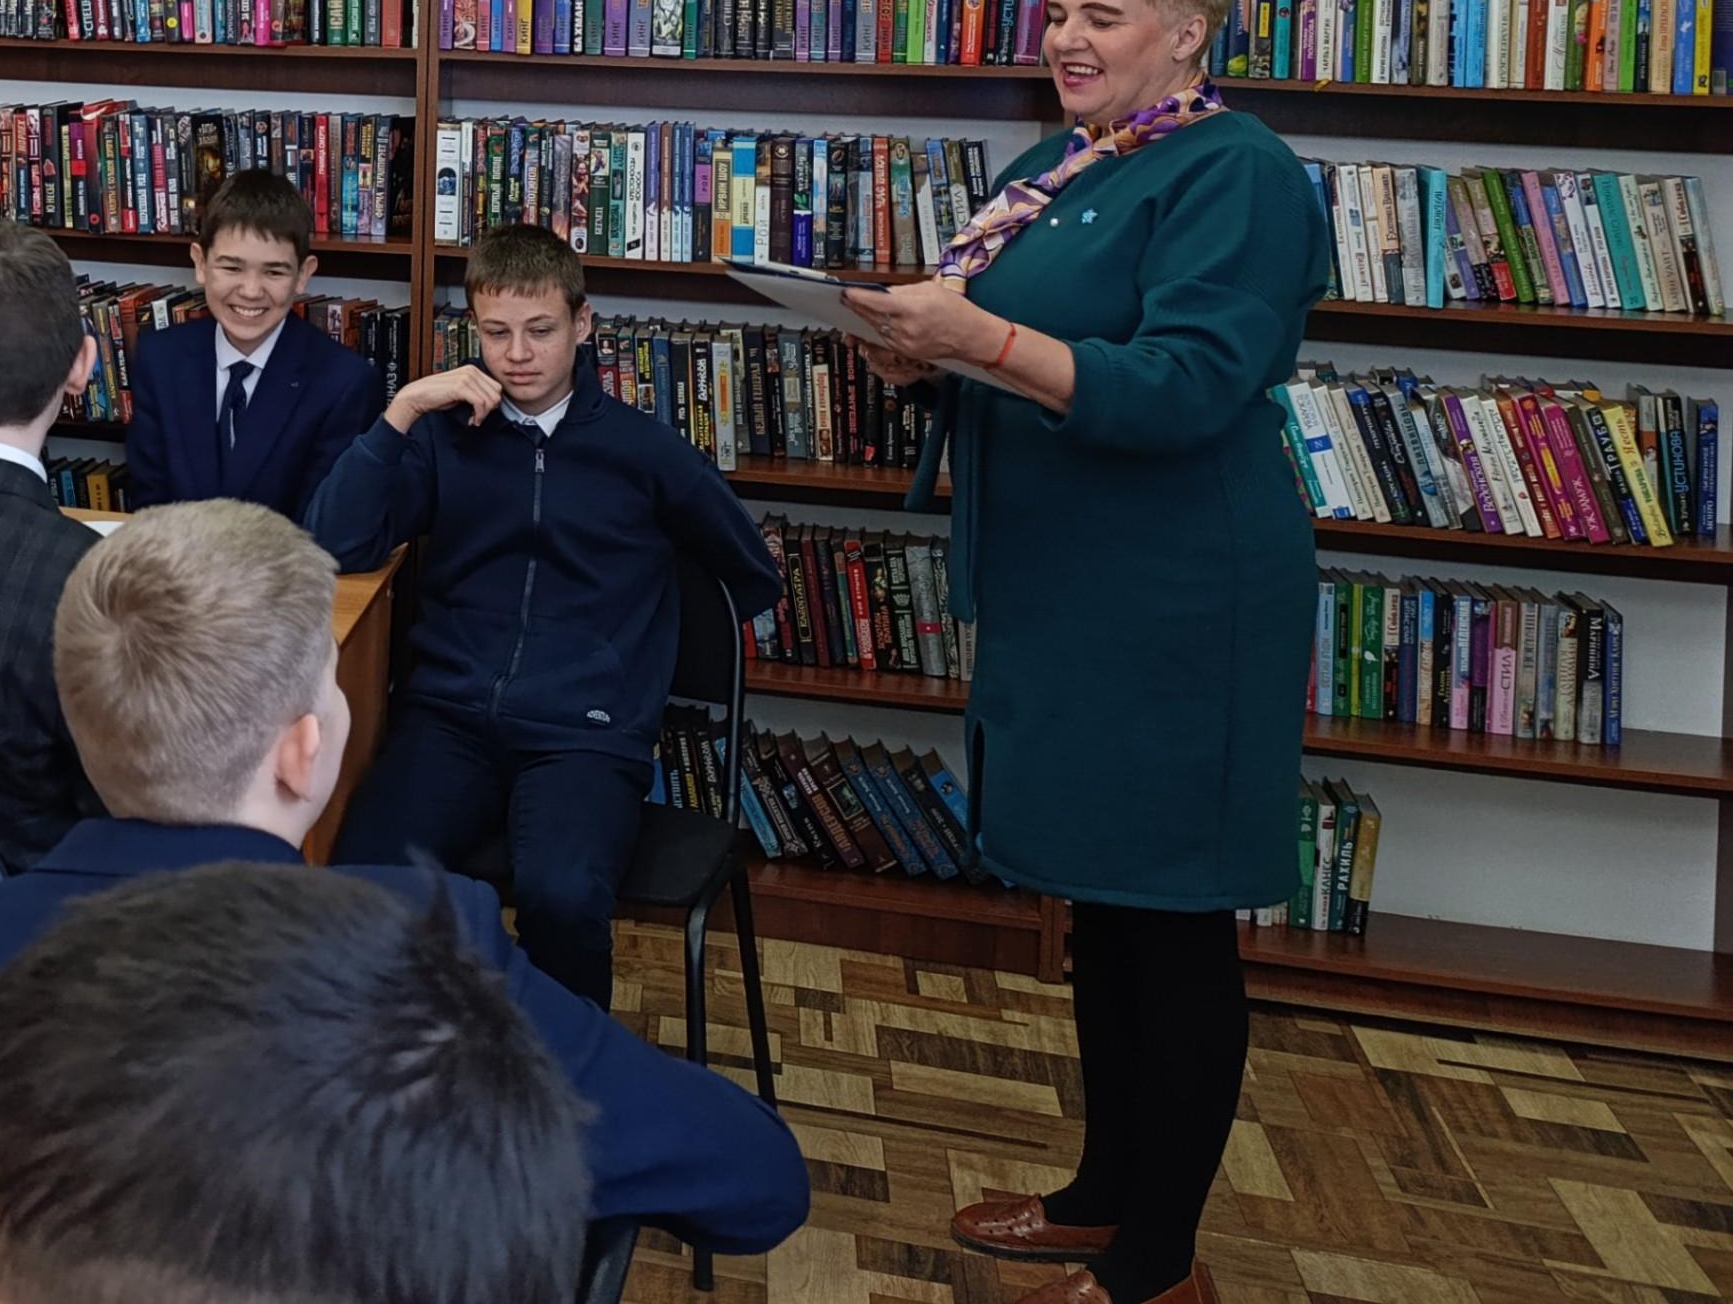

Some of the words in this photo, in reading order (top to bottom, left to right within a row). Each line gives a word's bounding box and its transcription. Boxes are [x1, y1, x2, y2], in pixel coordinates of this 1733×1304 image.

[519, 18, 528, 44] КИНГ
[574, 0, 583, 52] БАХМАН
[718, 183, 728, 210] ИРВИН
[749, 361, 763, 400] ГЕНЕРАЛ
[1399, 402, 1428, 465] ЛИТВИНОВЫ
[1597, 424, 1622, 471] ТРАУБ
[1669, 432, 1689, 494] УСТИНОВА
[1502, 653, 1513, 690] СТИЛ
[1336, 841, 1353, 891] РАХИЛЬ
